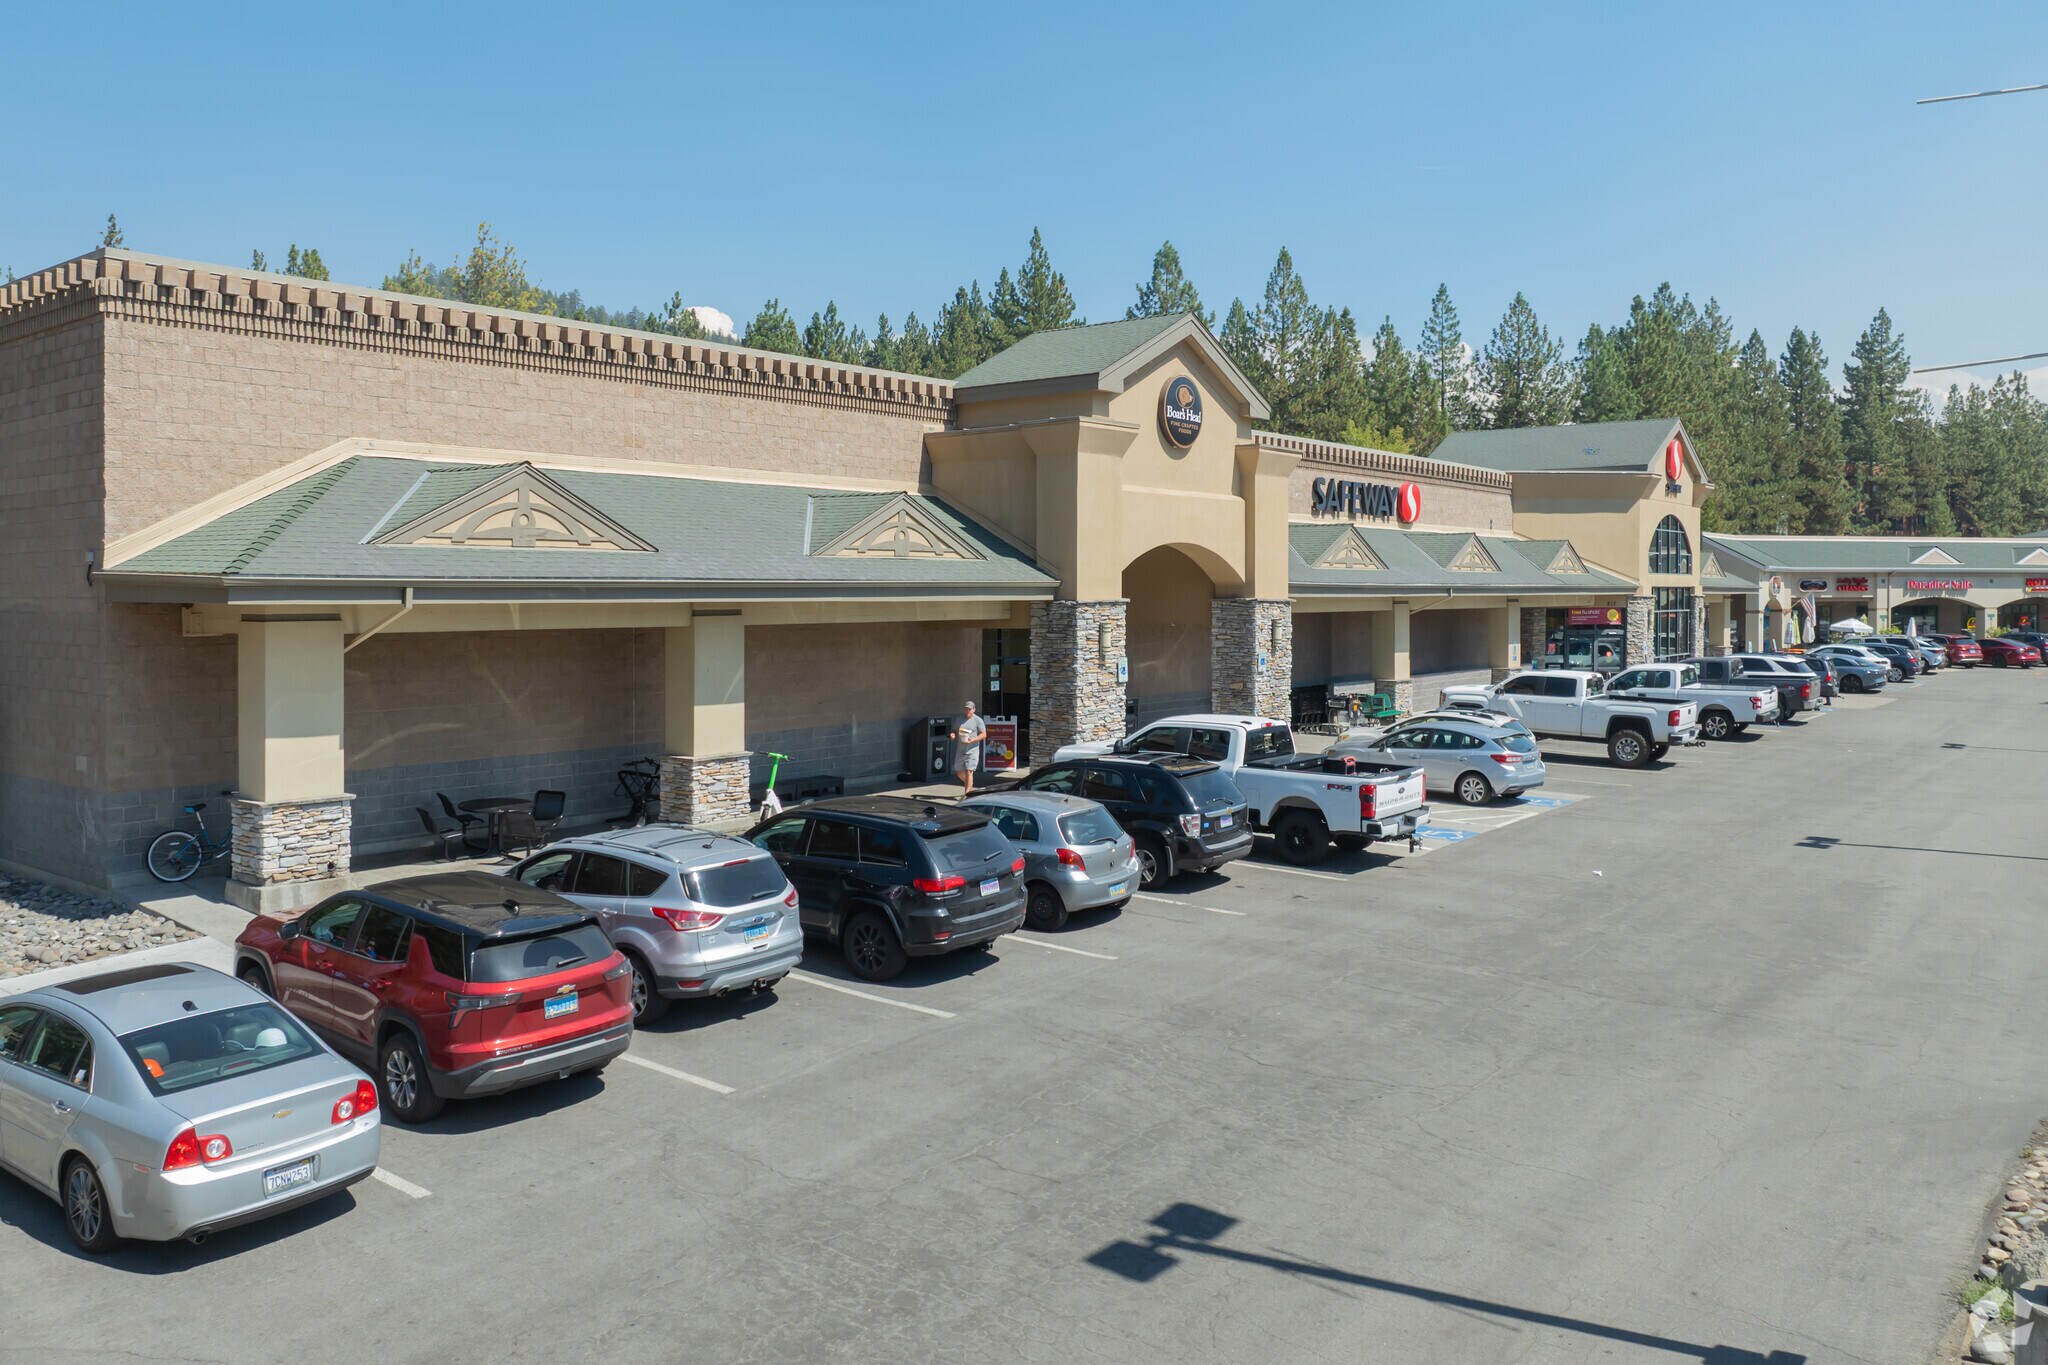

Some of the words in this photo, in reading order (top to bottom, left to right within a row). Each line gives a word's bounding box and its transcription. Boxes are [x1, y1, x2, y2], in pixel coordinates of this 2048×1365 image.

[1166, 405, 1185, 420] Boar's
[1186, 408, 1201, 423] Head
[1312, 477, 1399, 516] SAFEWAY
[1907, 579, 1949, 590] Paradise
[1379, 796, 1404, 805] SUPER
[1404, 791, 1421, 800] DUTY
[269, 1167, 309, 1189] 7CNW253
